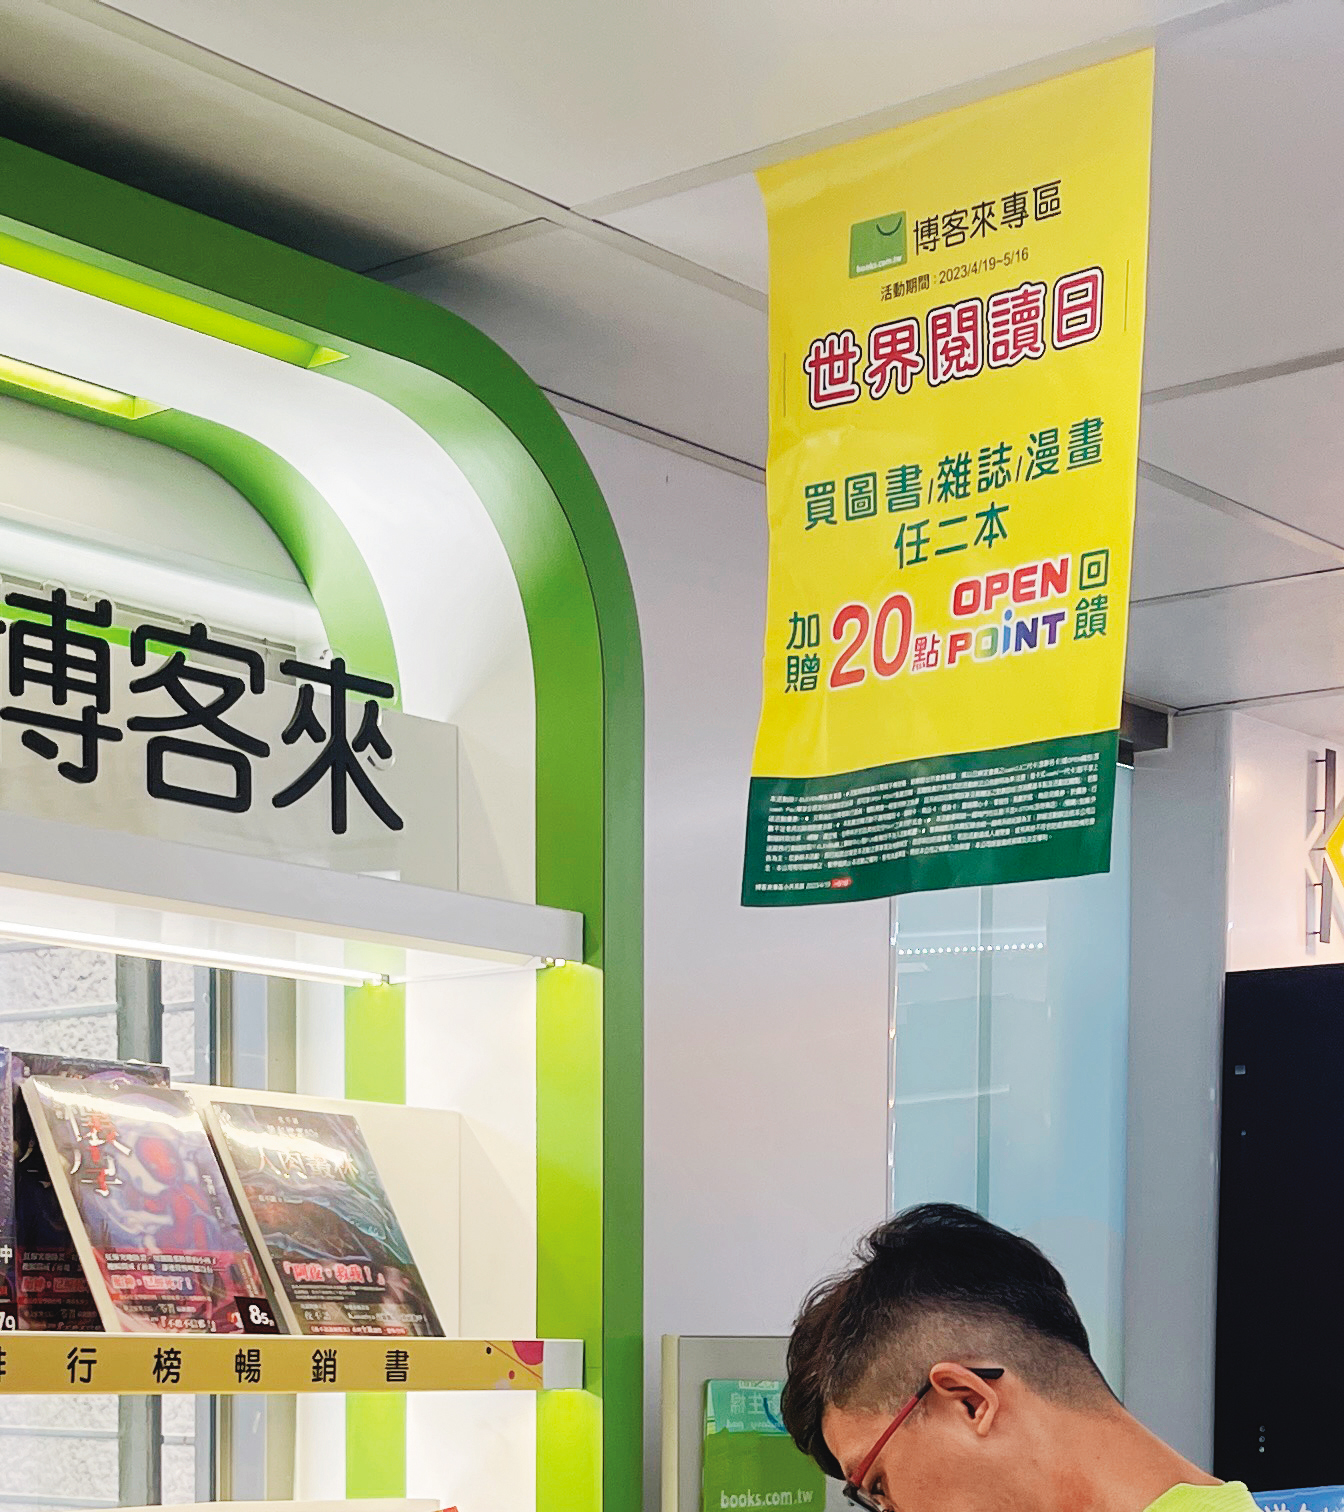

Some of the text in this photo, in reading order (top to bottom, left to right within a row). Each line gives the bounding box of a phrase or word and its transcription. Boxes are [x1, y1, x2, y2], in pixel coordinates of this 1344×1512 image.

[913, 180, 1062, 254] 博客來專區
[805, 267, 1103, 409] 世界閱讀日
[804, 417, 1104, 530] 買圖書/雜誌/漫畫
[895, 502, 1010, 569] 任二本
[953, 556, 1071, 617] OPEN
[785, 611, 820, 693] 加贈
[720, 1488, 814, 1509] books.com.tw
